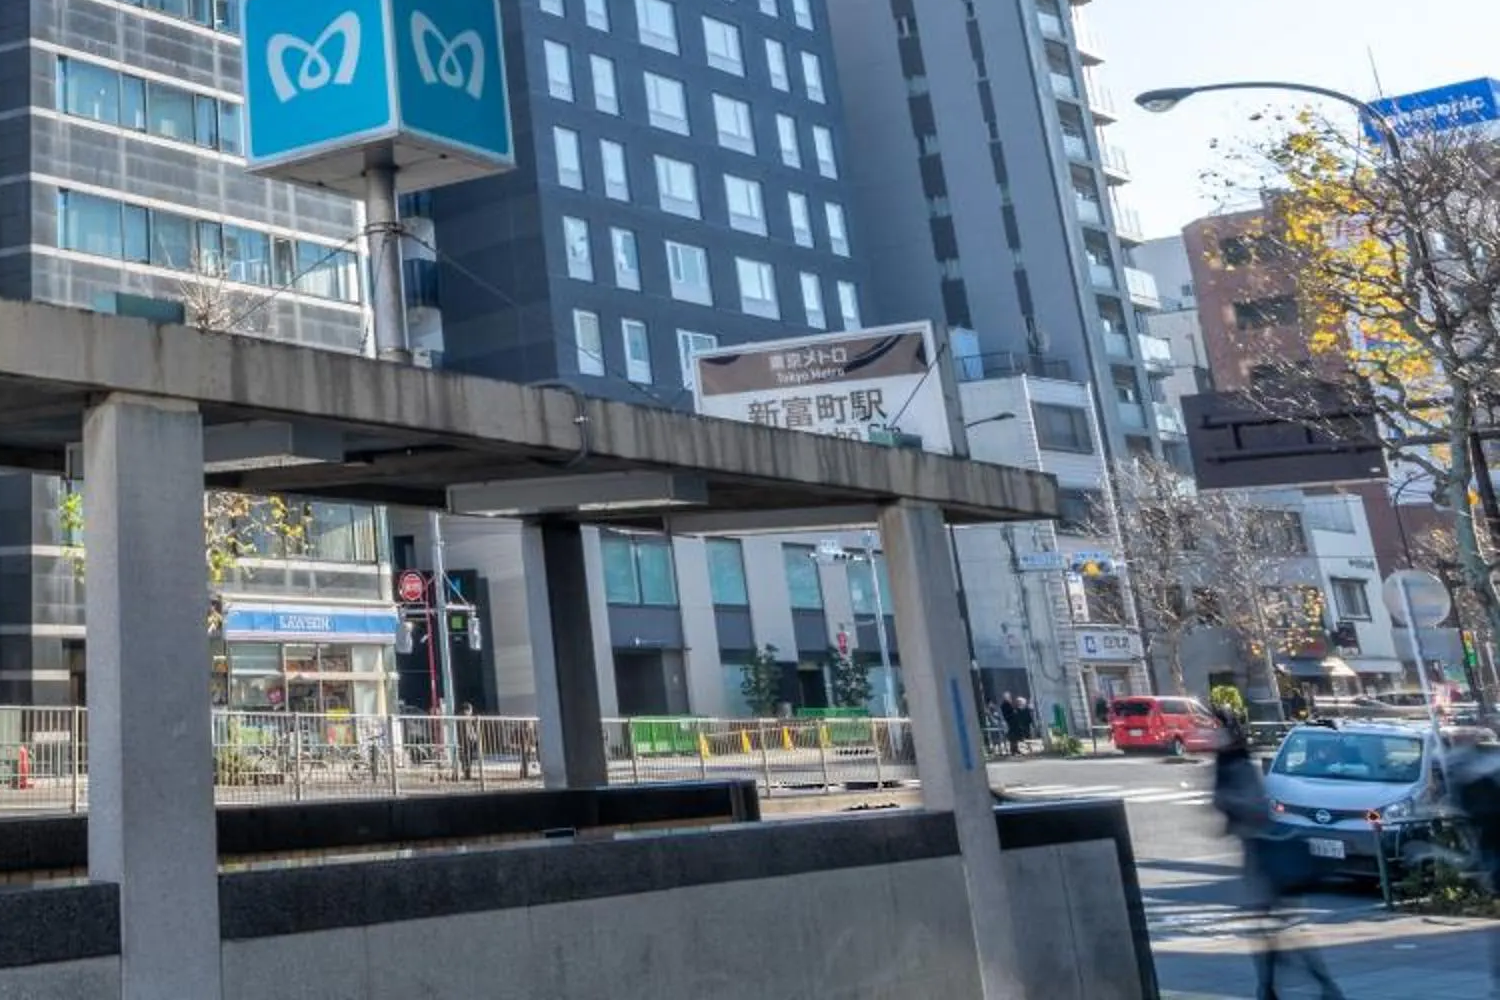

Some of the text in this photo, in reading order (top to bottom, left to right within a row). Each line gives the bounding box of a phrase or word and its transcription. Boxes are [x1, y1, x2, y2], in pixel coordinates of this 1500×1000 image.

[748, 388, 887, 429] 新富町駅
[279, 615, 332, 631] LAWSON
